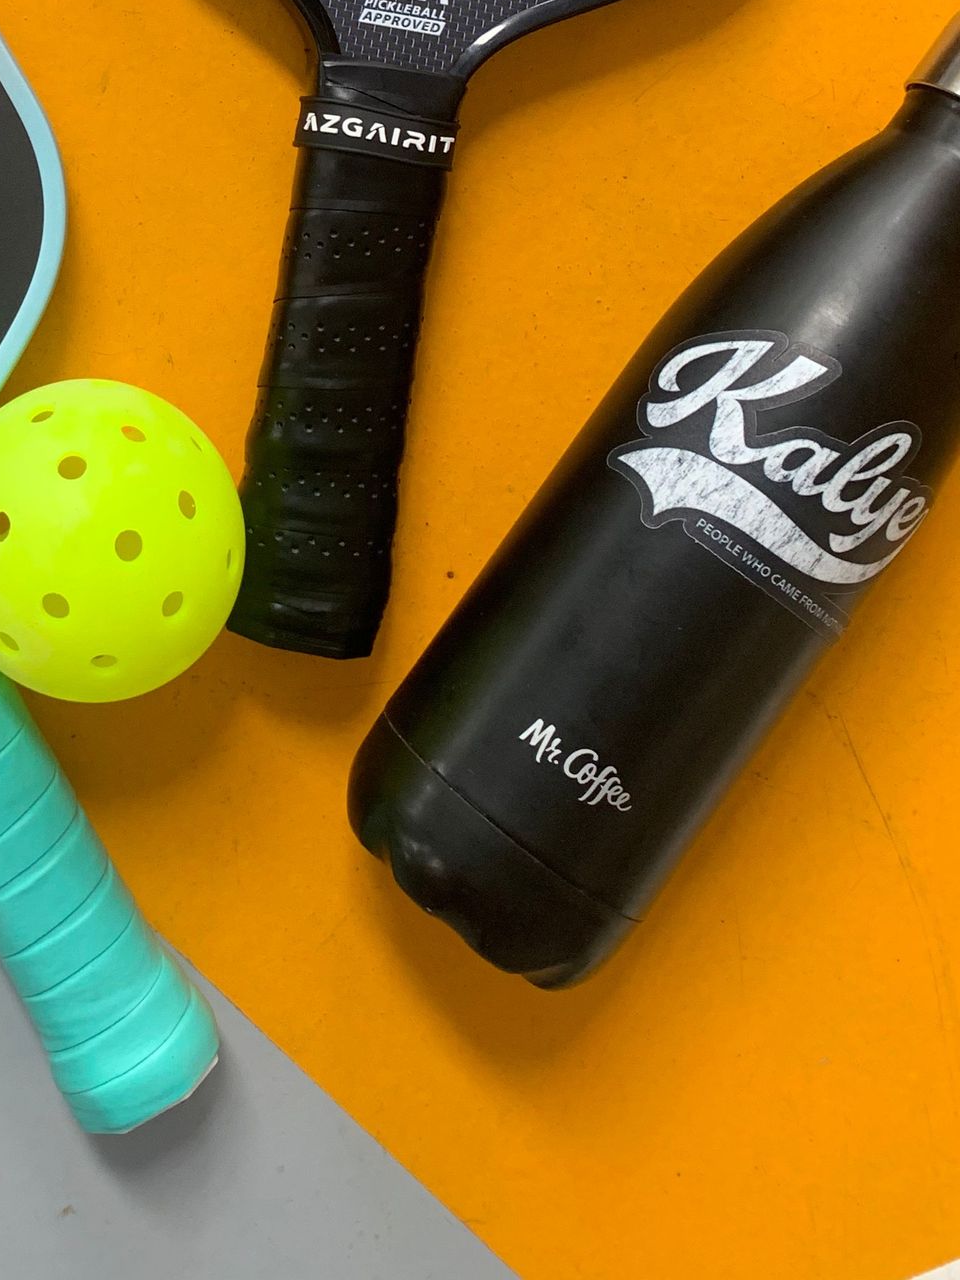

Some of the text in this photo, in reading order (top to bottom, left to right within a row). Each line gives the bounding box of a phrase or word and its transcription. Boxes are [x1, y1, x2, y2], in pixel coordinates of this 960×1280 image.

[360, 9, 444, 35] APPROVED
[303, 112, 455, 154] AZGAIRIT
[695, 518, 829, 619] PEOPLE WHO CAME FROM
[519, 718, 632, 811] Mr. Coffee
